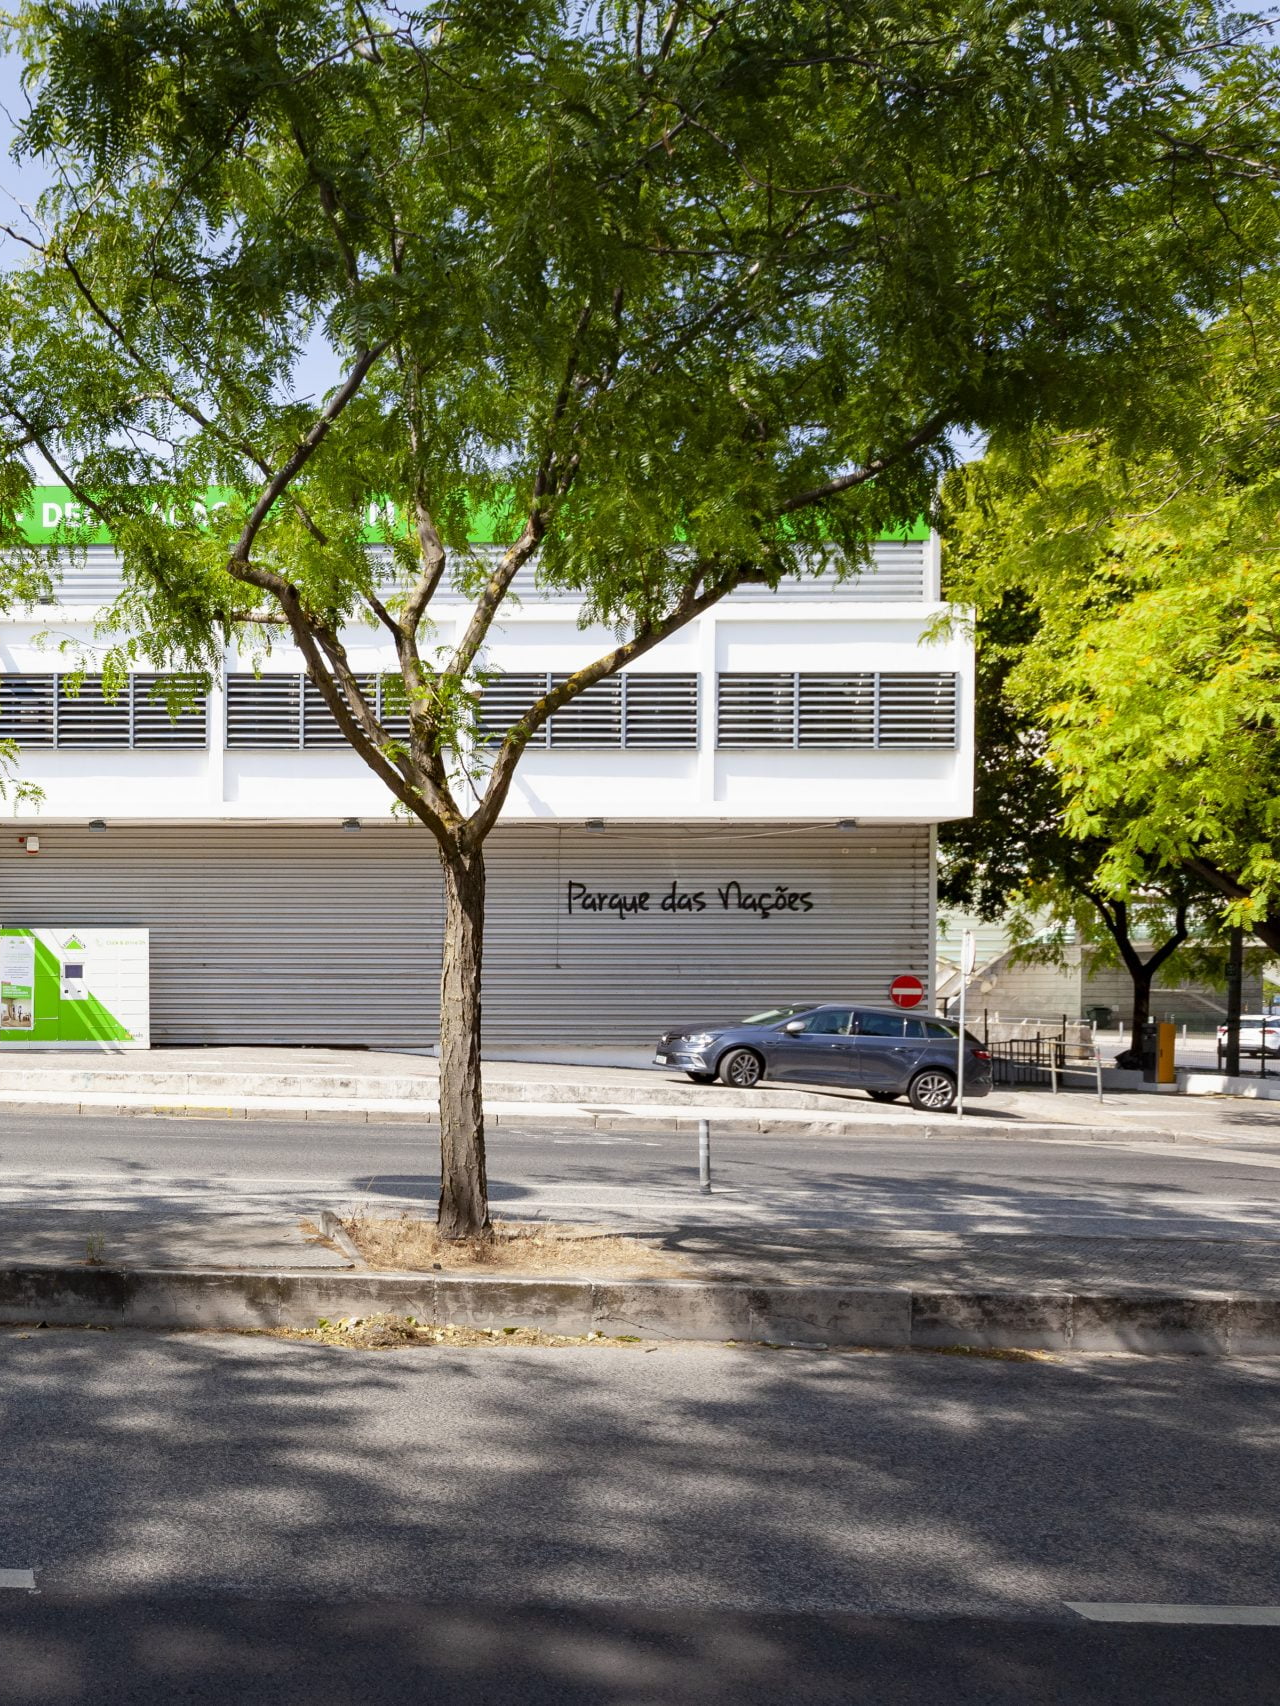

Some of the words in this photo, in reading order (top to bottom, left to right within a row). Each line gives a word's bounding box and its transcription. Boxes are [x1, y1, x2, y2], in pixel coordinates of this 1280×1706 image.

[568, 880, 650, 920] Parque
[661, 880, 707, 913] das
[718, 880, 814, 919] Nações
